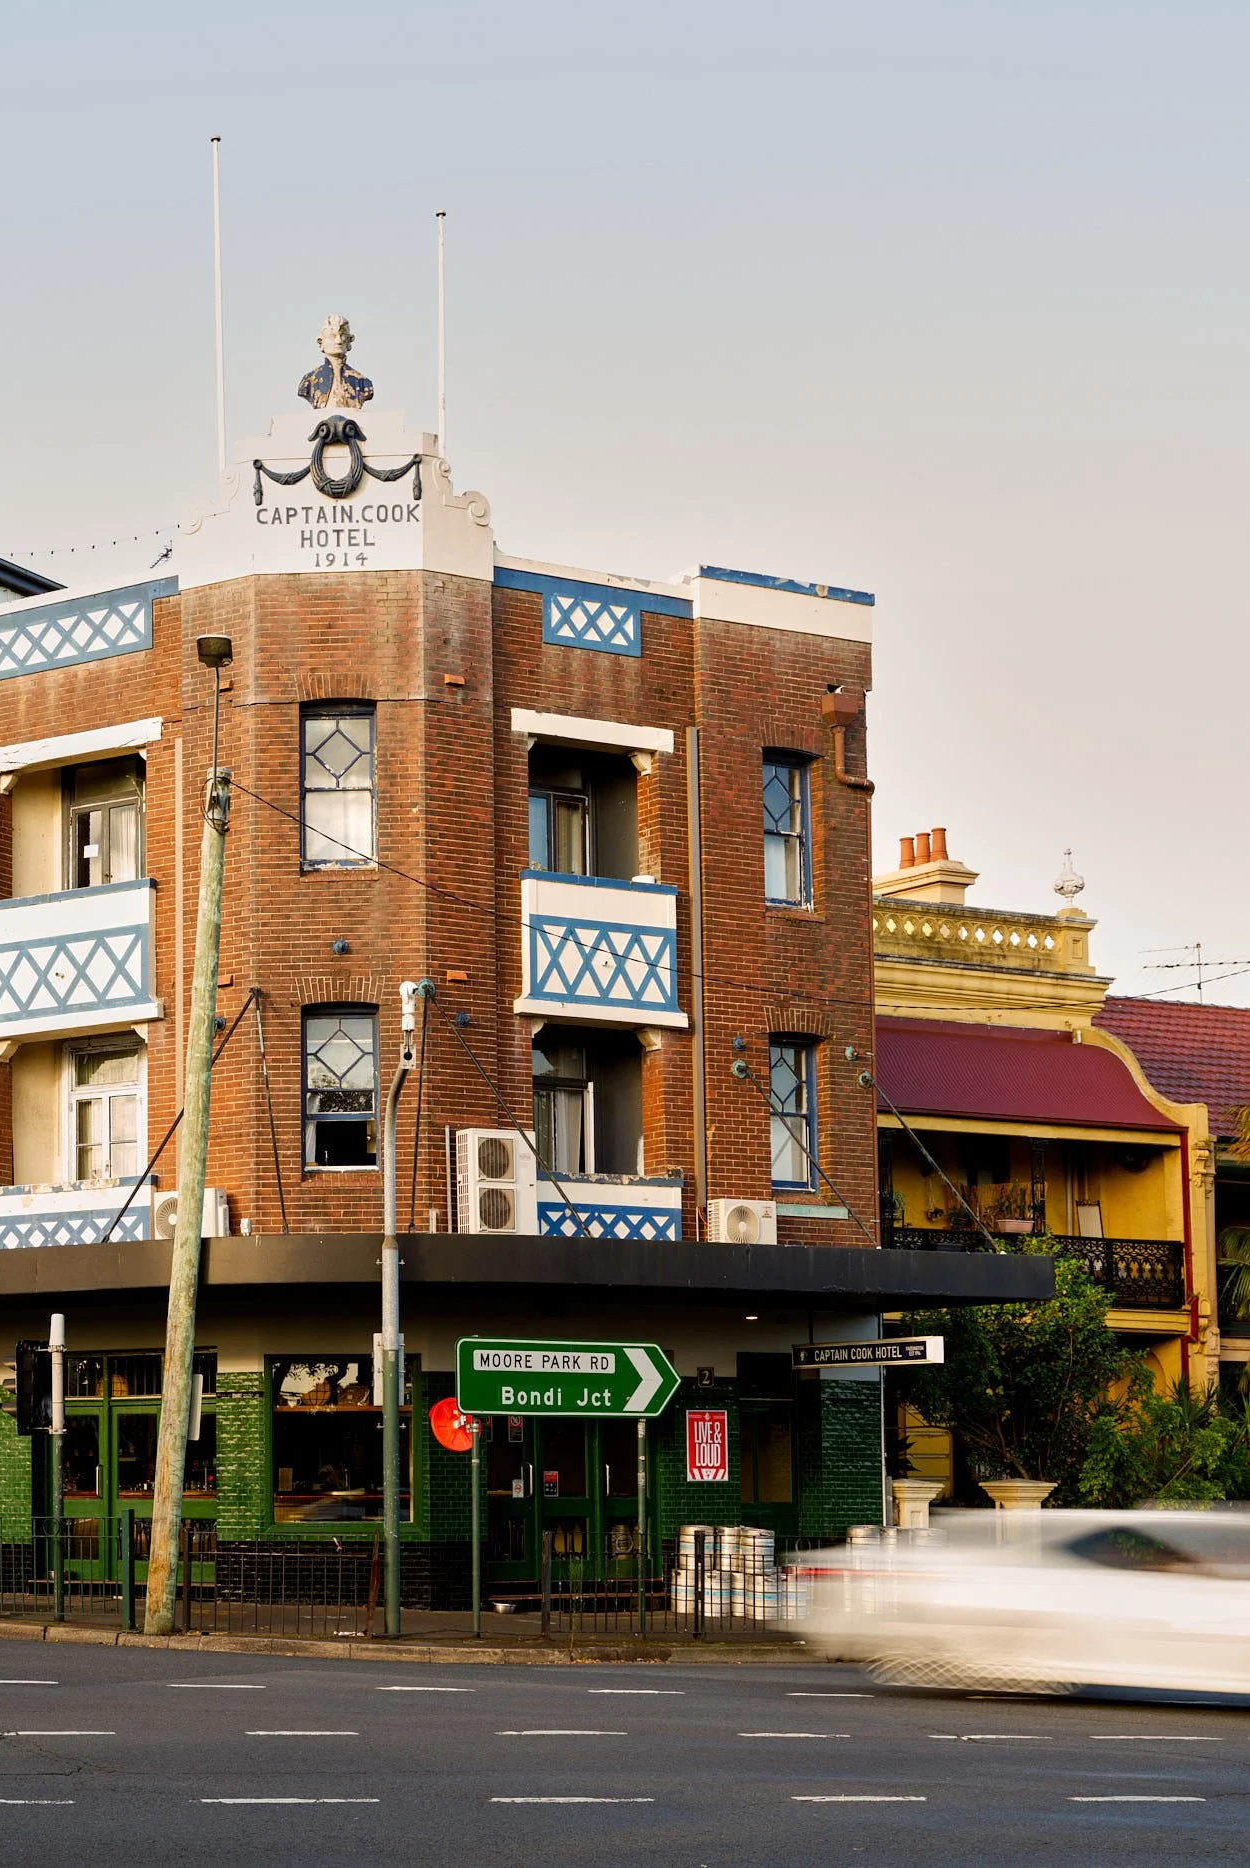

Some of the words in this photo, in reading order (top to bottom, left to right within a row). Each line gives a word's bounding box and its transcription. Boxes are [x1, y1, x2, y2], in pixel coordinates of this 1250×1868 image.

[300, 528, 376, 548] HOTEL
[315, 552, 368, 567] 1914
[480, 1353, 533, 1369] MOORE
[542, 1355, 581, 1370] PARK
[590, 1356, 609, 1370] RD
[814, 1348, 849, 1362] CAPTAIN
[850, 1347, 873, 1360] COOK
[875, 1345, 903, 1358] HOTEL
[701, 1370, 710, 1385] 2
[501, 1386, 562, 1406] Bondi
[576, 1388, 612, 1407] Jct
[693, 1421, 712, 1443] LIVE
[713, 1421, 722, 1444] &
[695, 1443, 721, 1467] LOUD
